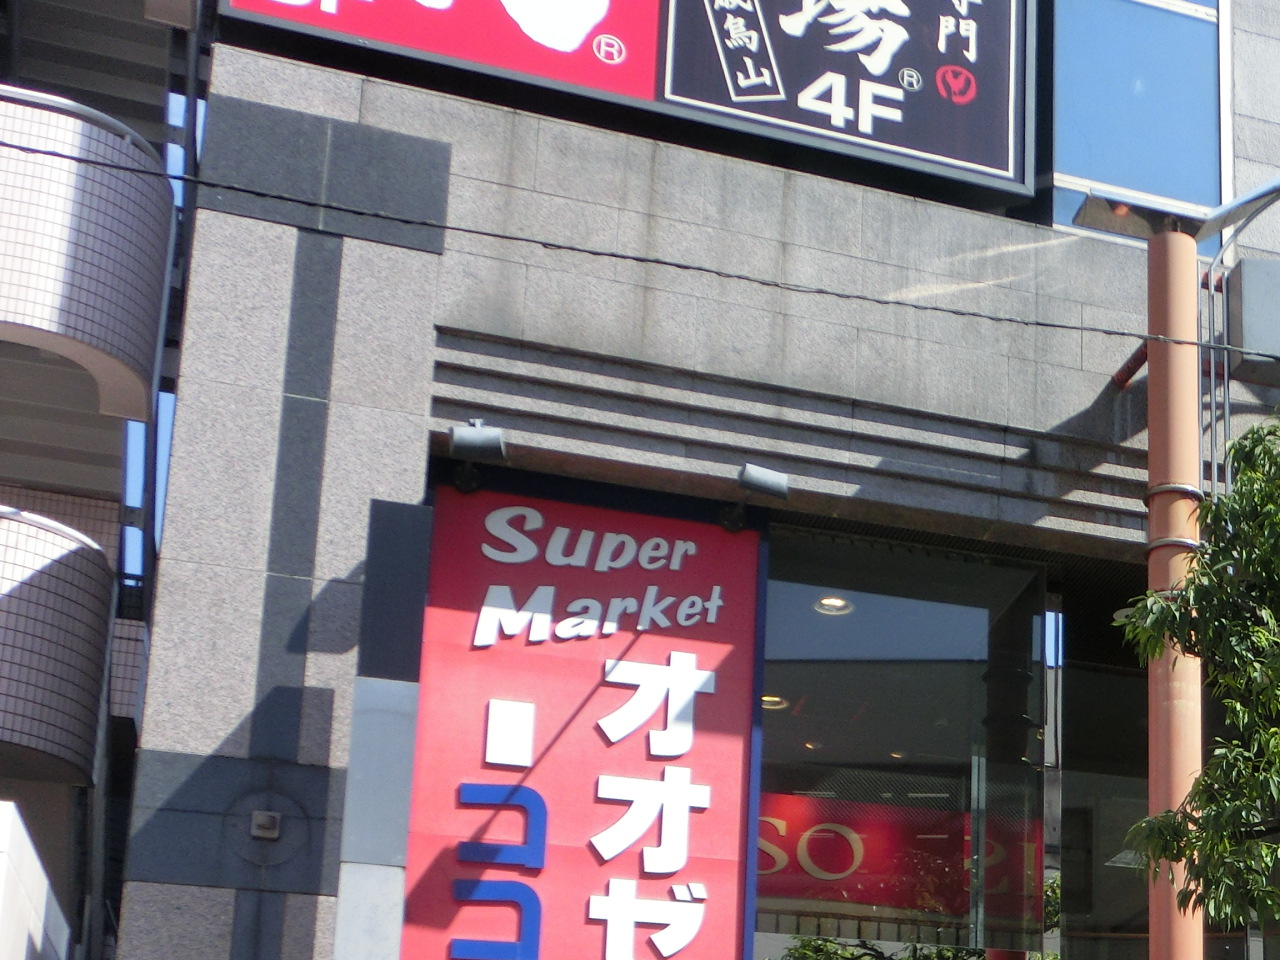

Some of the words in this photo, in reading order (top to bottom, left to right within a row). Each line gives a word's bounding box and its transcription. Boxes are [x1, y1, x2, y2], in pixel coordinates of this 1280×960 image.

[797, 71, 905, 135] 4F
[482, 505, 697, 572] Super
[472, 585, 723, 647] Market
